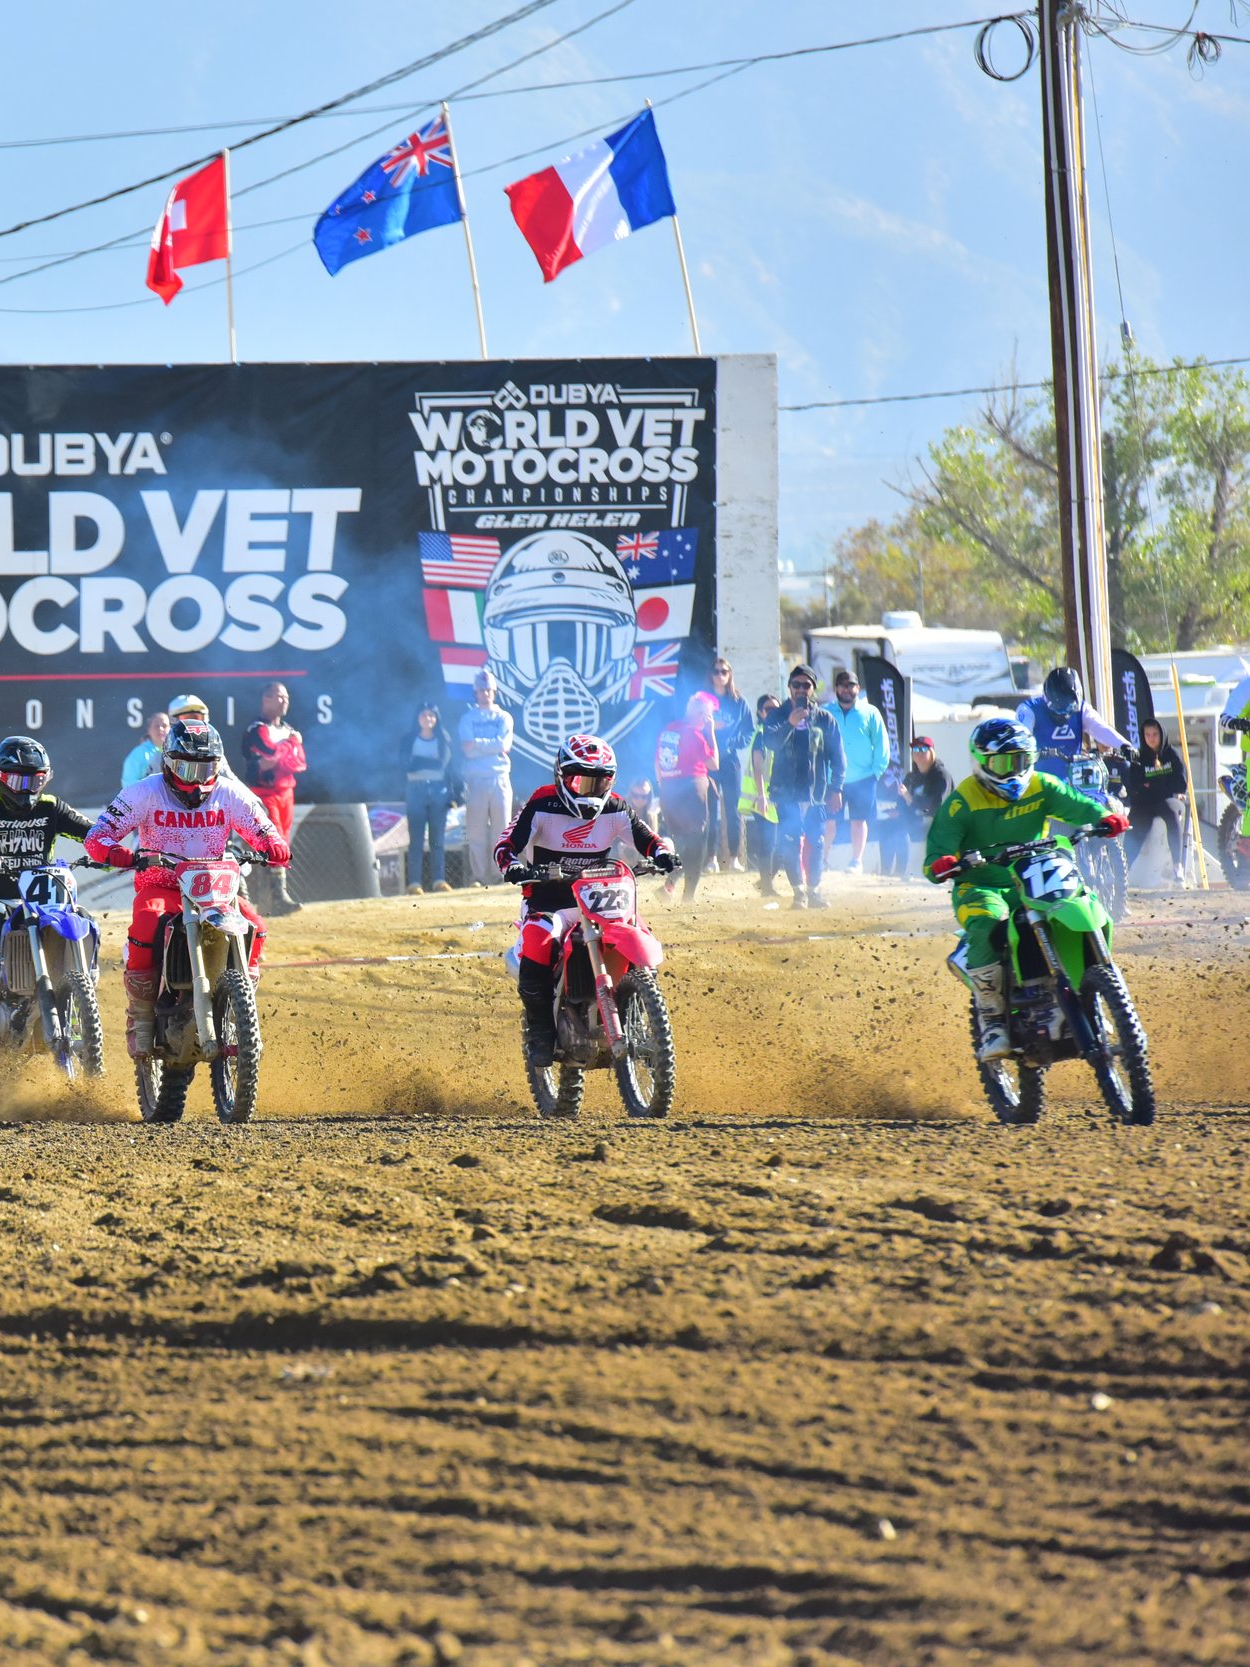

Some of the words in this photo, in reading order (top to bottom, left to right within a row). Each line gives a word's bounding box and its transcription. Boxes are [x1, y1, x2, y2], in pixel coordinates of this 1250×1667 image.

[529, 384, 618, 405] DUBYA
[607, 408, 705, 448] VET
[414, 447, 698, 486] MOTOCROSS
[449, 486, 668, 505] CHAMPIONSHIPS
[140, 487, 362, 574] VET
[475, 513, 548, 530] GLEN
[549, 511, 641, 529] HELEN
[1121, 670, 1141, 751] sterisk
[153, 809, 225, 829] CANADA
[26, 874, 71, 905] 41
[190, 872, 234, 897] 84
[1022, 858, 1079, 899] 12
[588, 889, 630, 913] 223
